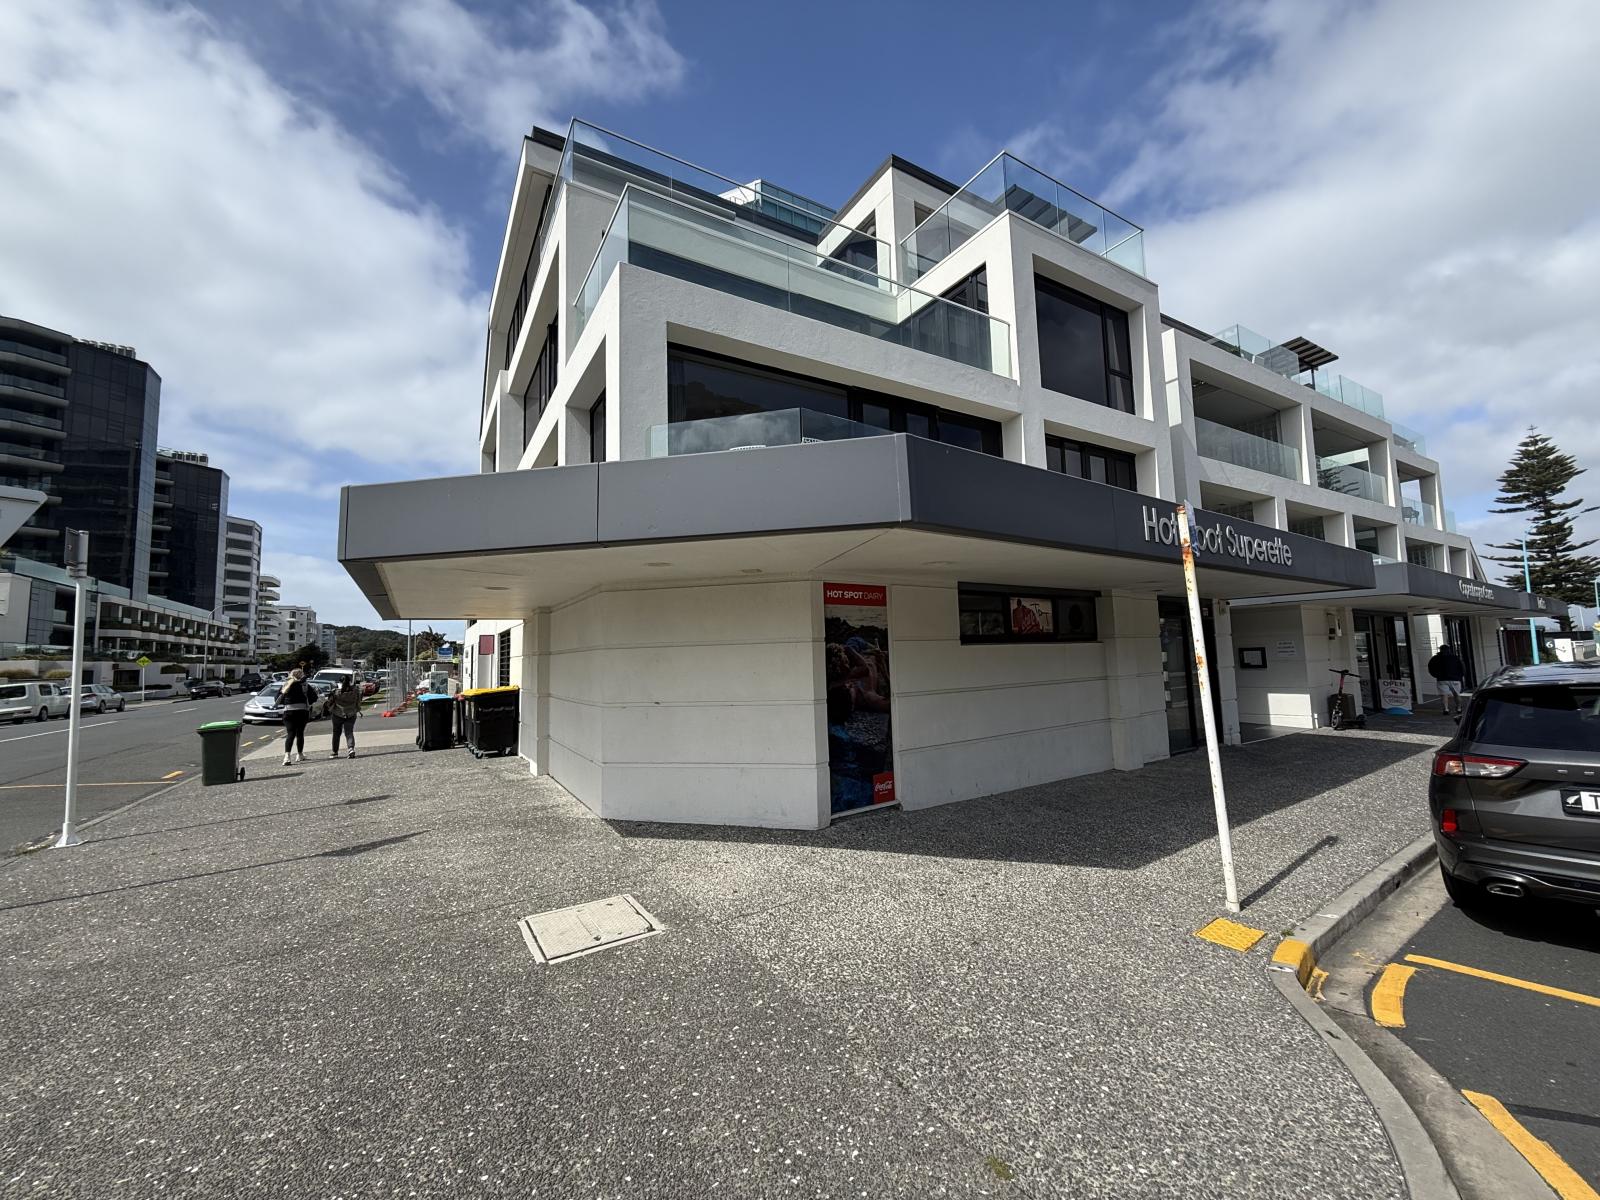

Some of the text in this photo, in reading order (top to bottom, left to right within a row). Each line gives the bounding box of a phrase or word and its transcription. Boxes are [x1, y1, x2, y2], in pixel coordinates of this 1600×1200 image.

[1143, 505, 1292, 566] Hot pot Superette
[827, 590, 883, 600] HOT SPOT DAIRY
